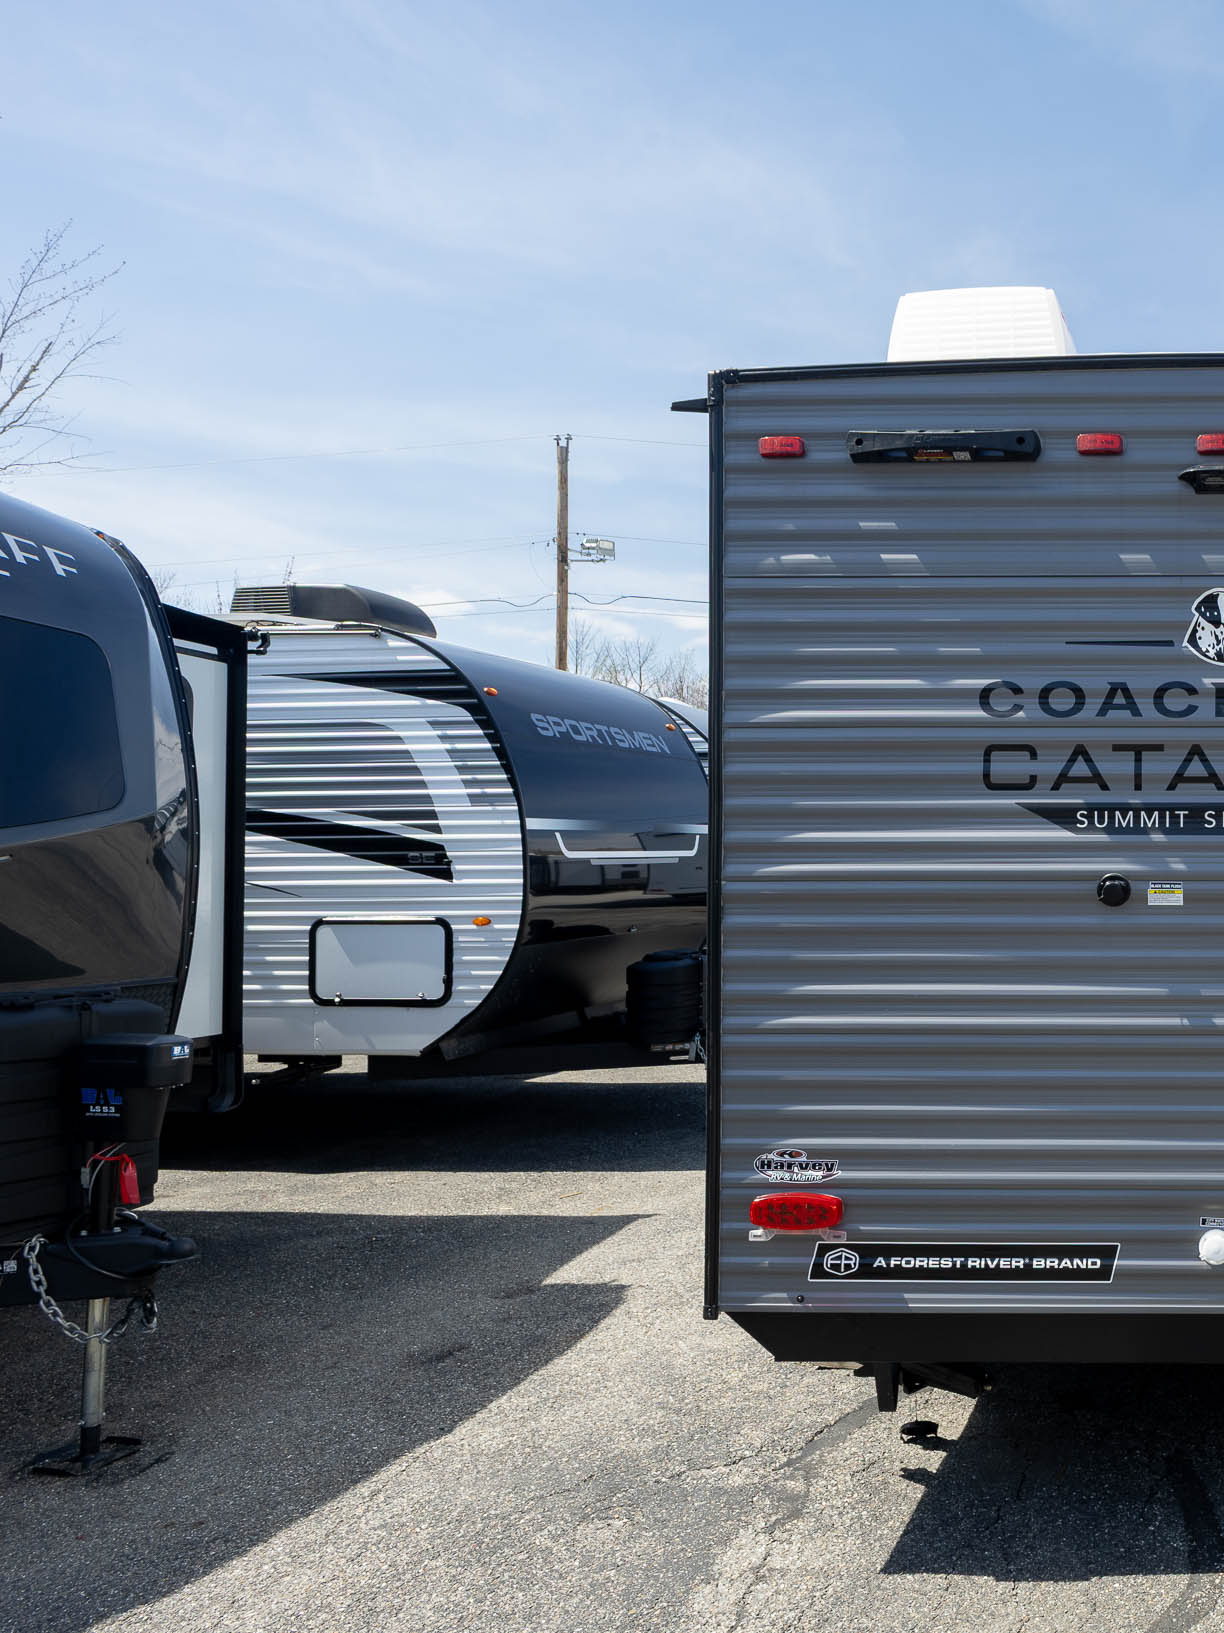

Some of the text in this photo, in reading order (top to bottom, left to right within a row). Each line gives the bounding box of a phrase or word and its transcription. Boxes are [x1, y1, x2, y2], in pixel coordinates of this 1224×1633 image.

[0, 532, 78, 577] FF
[530, 712, 671, 754] SPORTSMEN
[1076, 810, 1189, 828] SUMMIT
[759, 1159, 836, 1174] Harvey
[770, 1172, 822, 1182] RV & Marine
[873, 1257, 887, 1268] A
[890, 1257, 965, 1269] FOREST
[1032, 1257, 1101, 1269] BRAND
